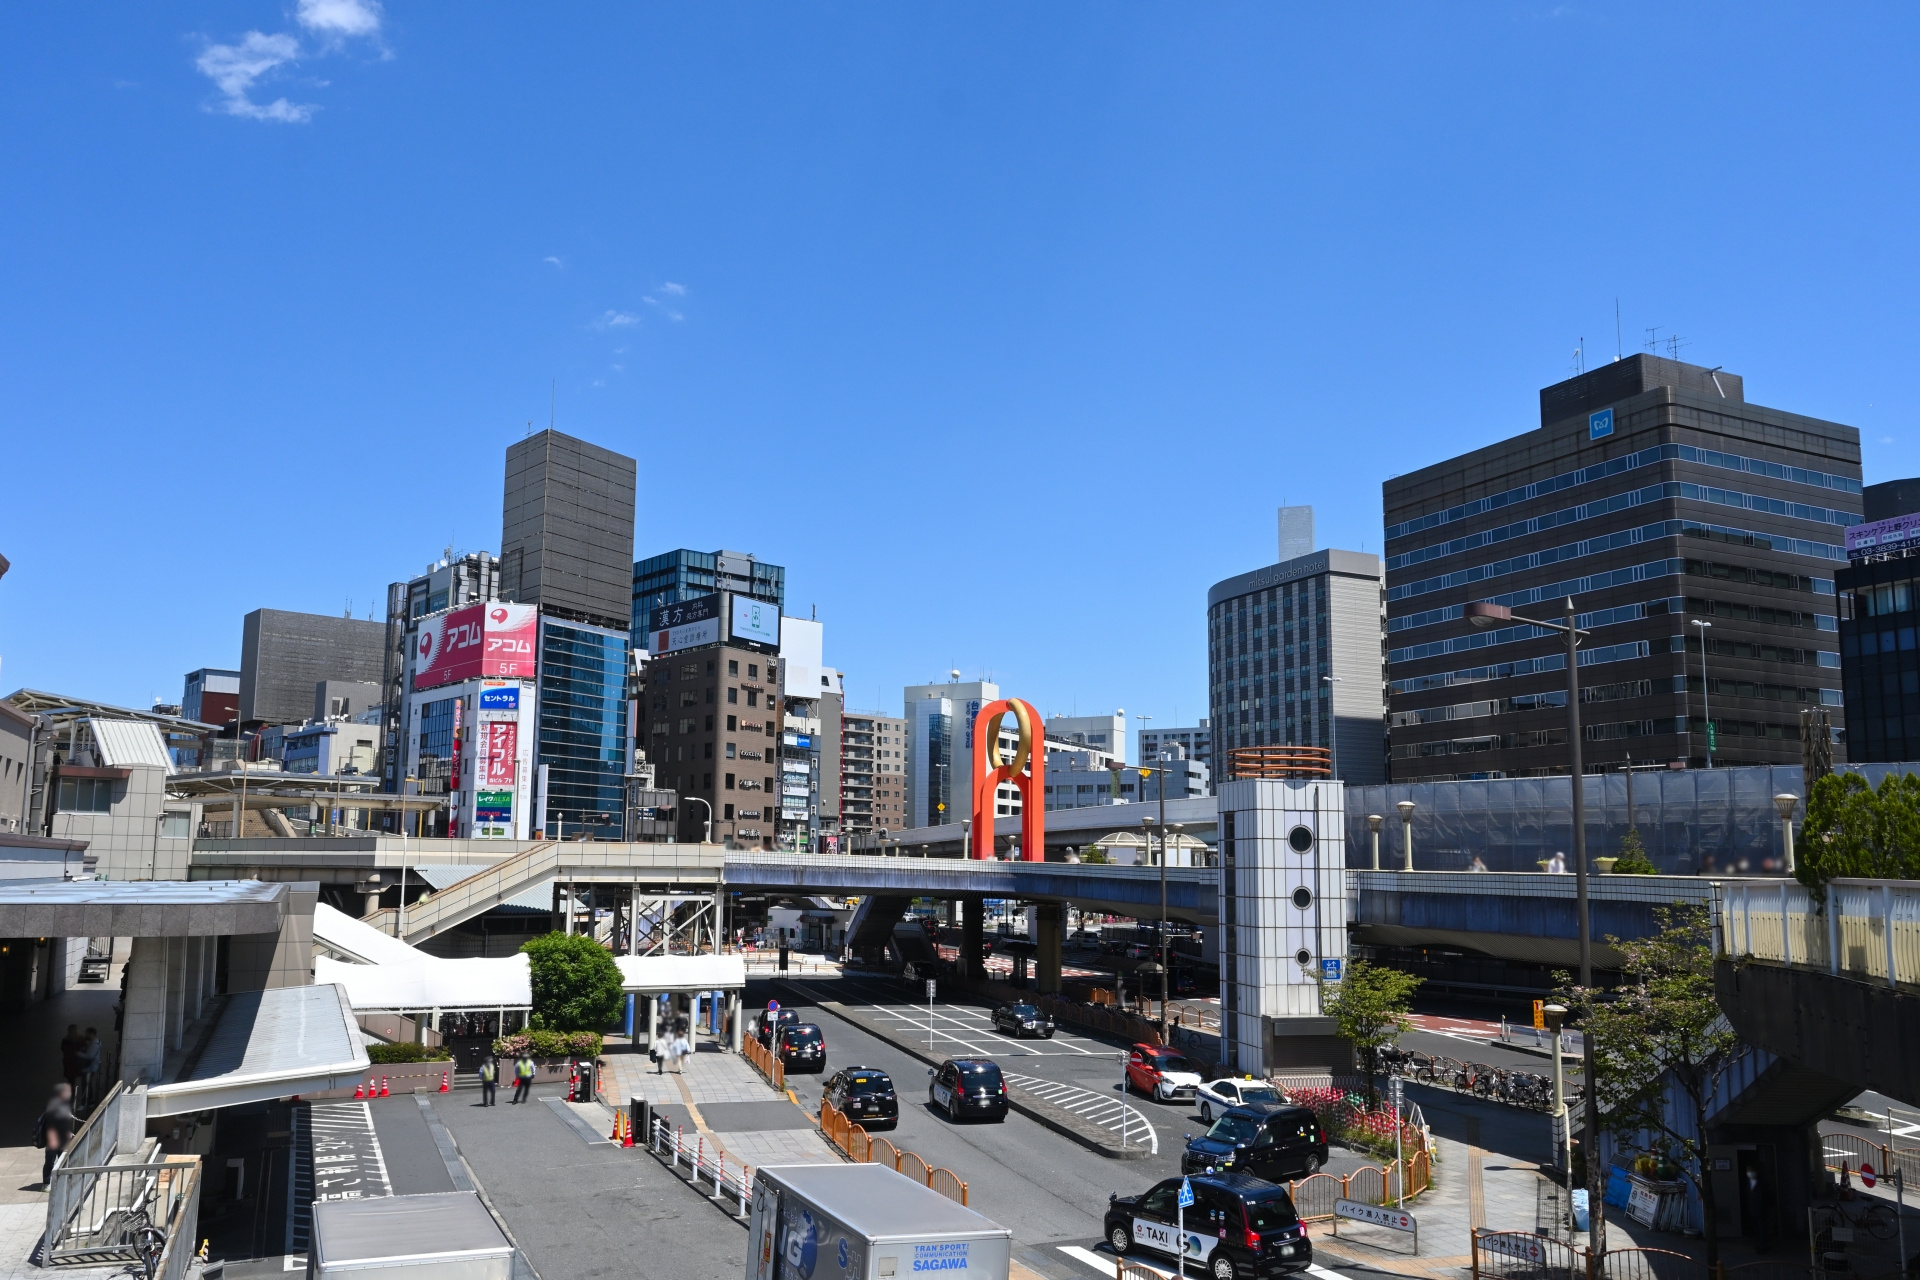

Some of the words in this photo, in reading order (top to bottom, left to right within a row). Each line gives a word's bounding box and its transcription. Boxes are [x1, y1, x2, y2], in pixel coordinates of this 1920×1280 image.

[1248, 575, 1272, 589] mitsui
[1273, 562, 1303, 584] garden
[1304, 558, 1326, 573] hotel
[659, 607, 684, 626] 漢方
[446, 622, 481, 653] アコム
[488, 638, 531, 653] アコム
[444, 670, 452, 681] 5F
[500, 663, 518, 674] 5F
[484, 694, 515, 702] セントラル
[491, 725, 506, 775] アイフル
[1341, 1205, 1398, 1224] バイク進入禁止
[1147, 1226, 1168, 1244] TAXI
[914, 1251, 968, 1259] COMMUNICATION
[913, 1258, 968, 1272] SAGAWA
